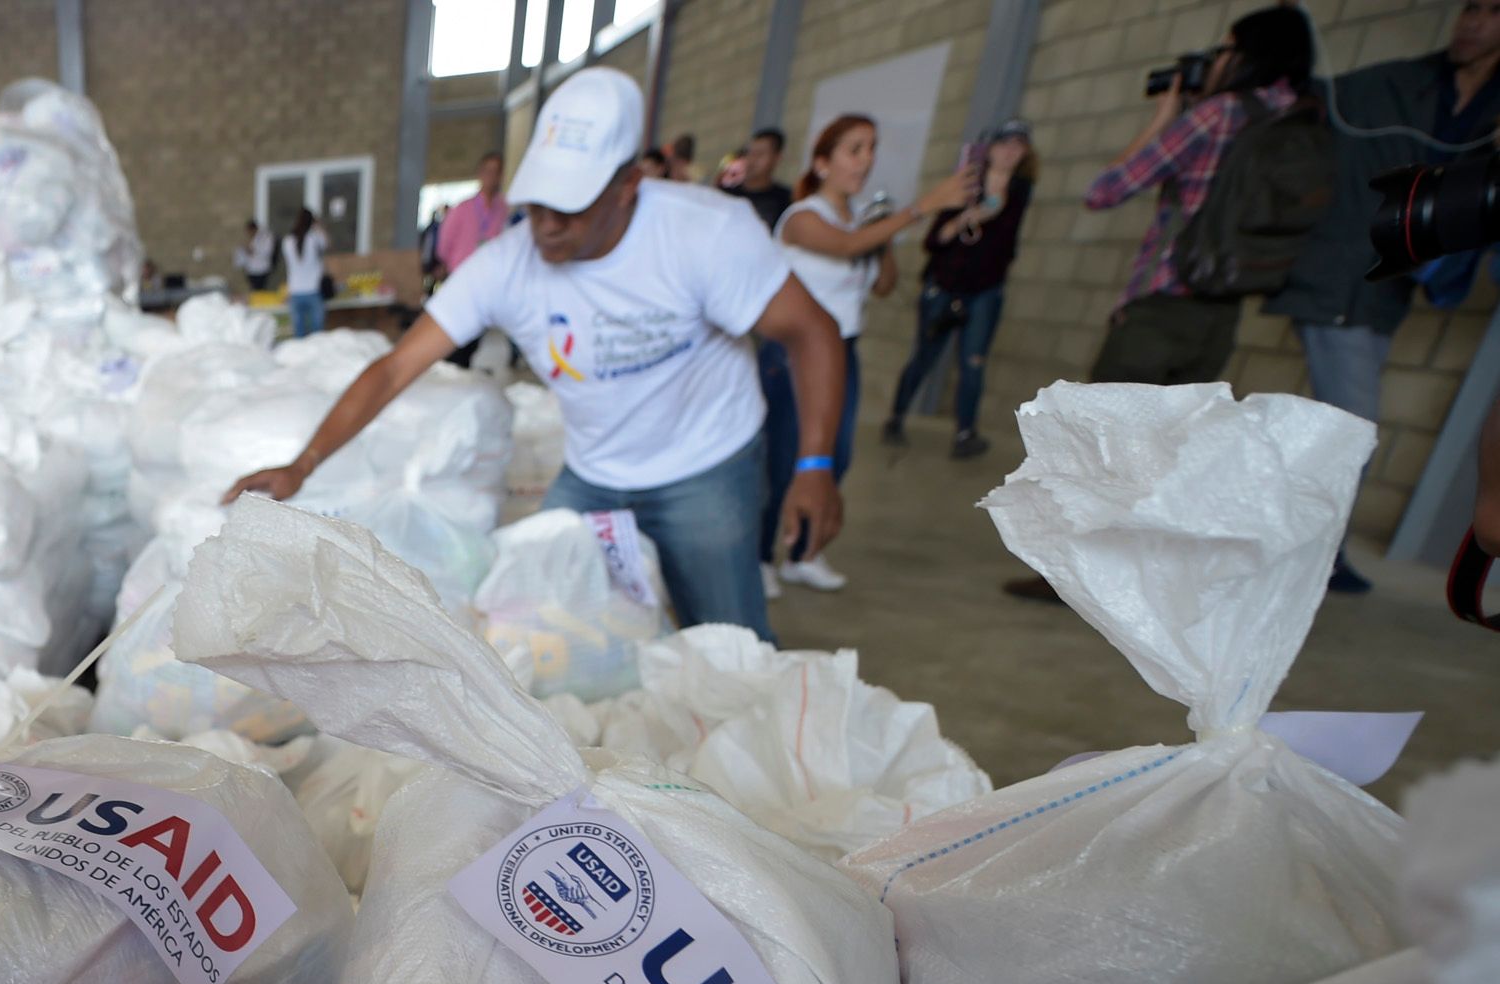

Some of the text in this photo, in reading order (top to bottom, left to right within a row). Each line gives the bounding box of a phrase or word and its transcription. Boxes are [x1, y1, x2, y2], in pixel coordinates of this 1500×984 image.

[14, 841, 183, 968] UNIDOS DE AMÉRICA
[25, 792, 256, 952] USAID
[35, 830, 102, 856] PUEBLO
[103, 850, 134, 872] DE
[133, 866, 171, 899] LOS
[165, 899, 221, 984] ESTADOS
[499, 842, 627, 955] INTERNATIONAL DEVELOPMENT
[548, 825, 652, 923] UNITED STATES AGENCY
[575, 849, 622, 894] USAID
